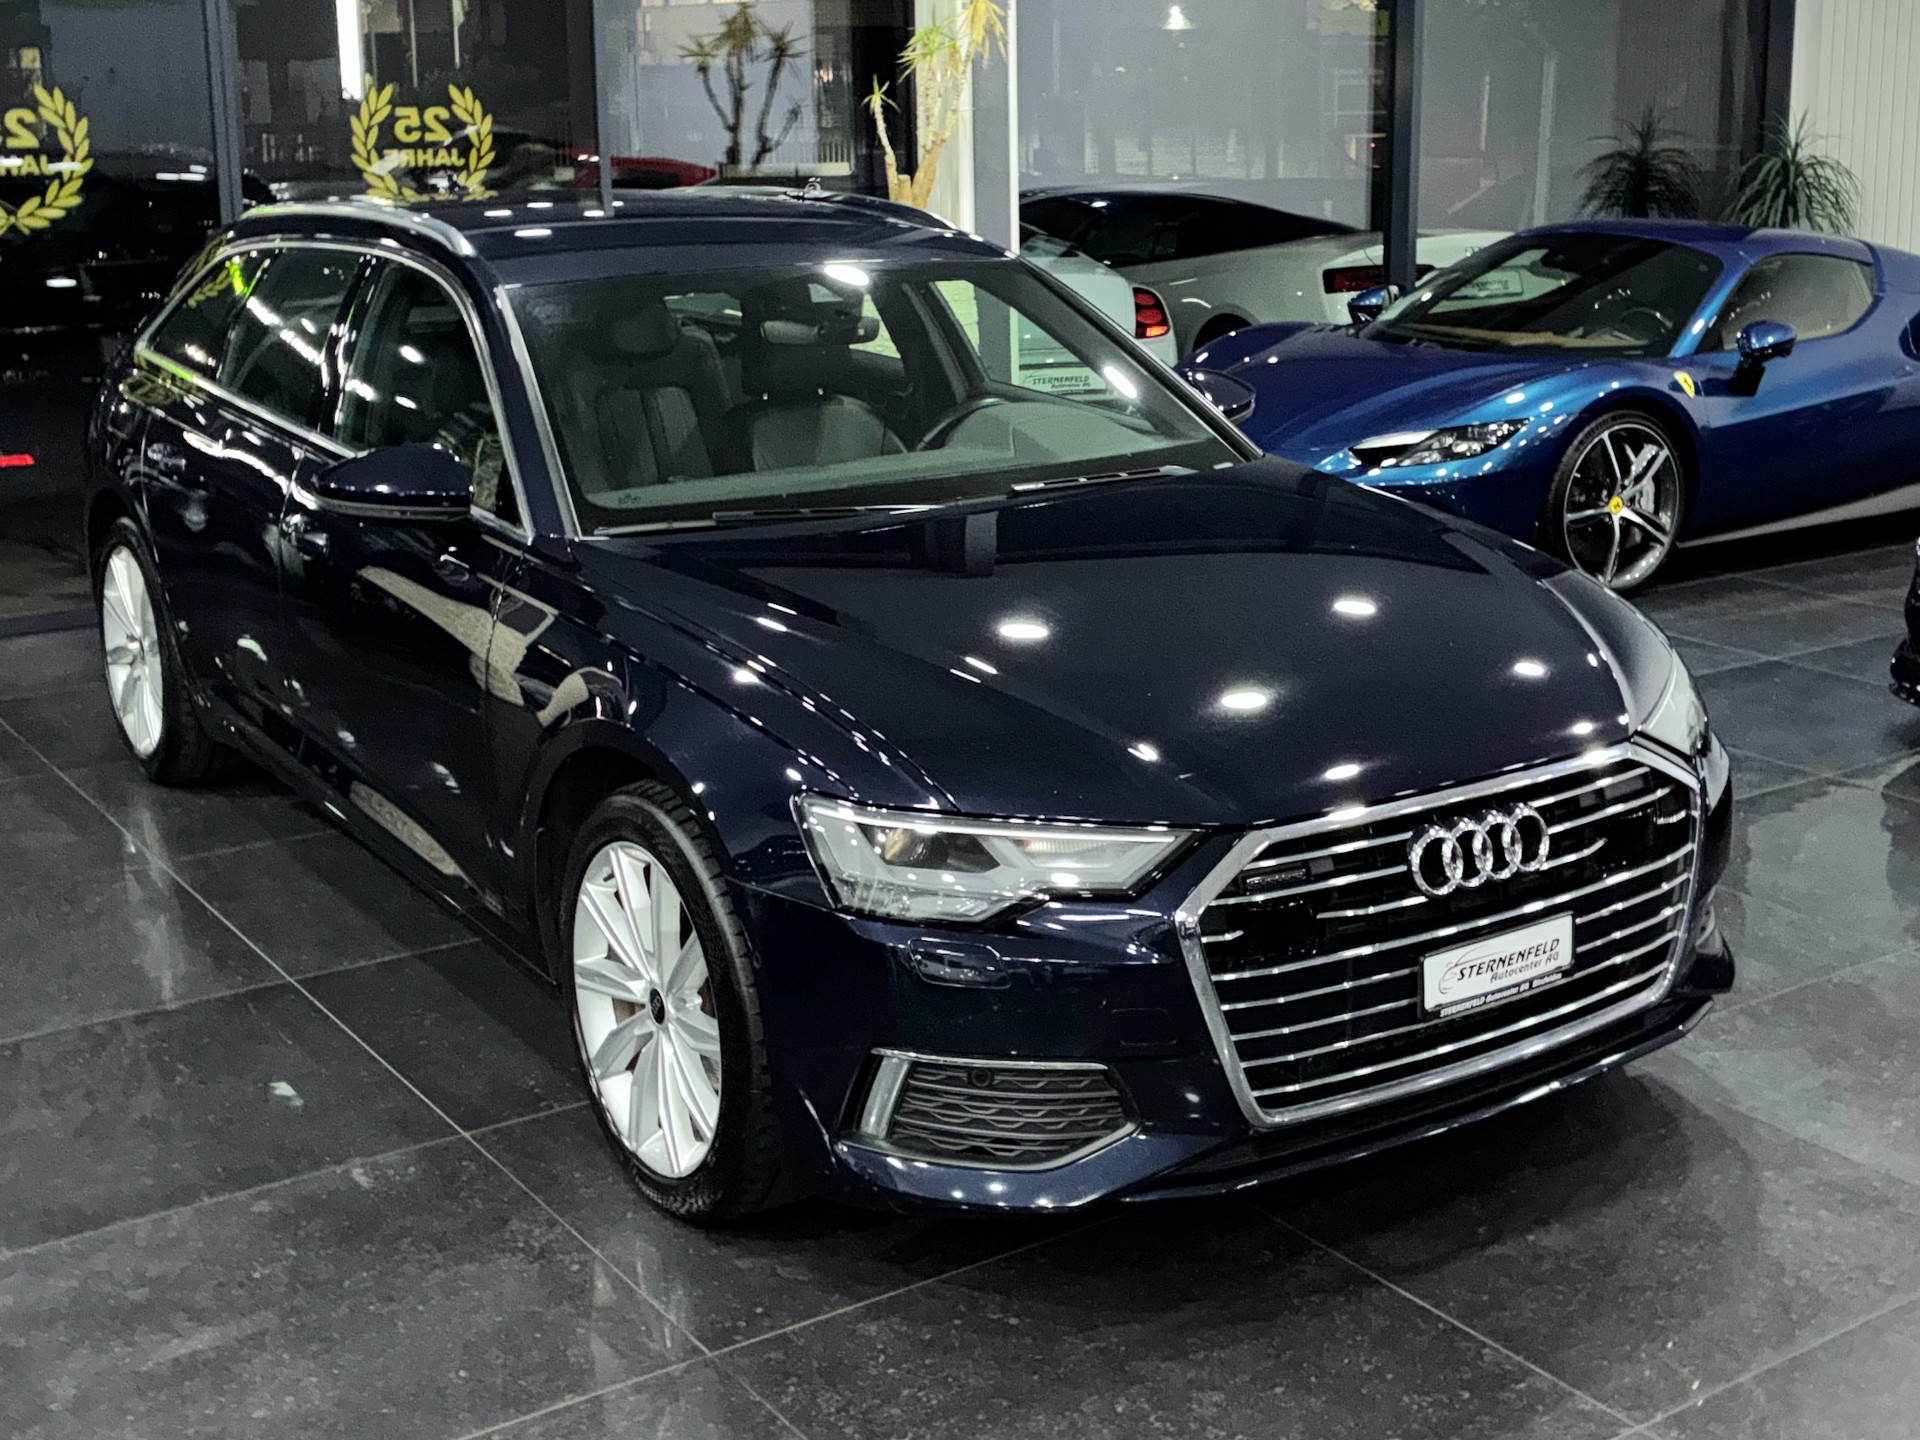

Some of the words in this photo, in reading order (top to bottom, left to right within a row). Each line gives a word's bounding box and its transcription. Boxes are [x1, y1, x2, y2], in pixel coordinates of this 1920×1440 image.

[1457, 938, 1560, 982] STERNENFELD
[1490, 959, 1543, 983] Autocenter
[1545, 951, 1560, 966] AG
